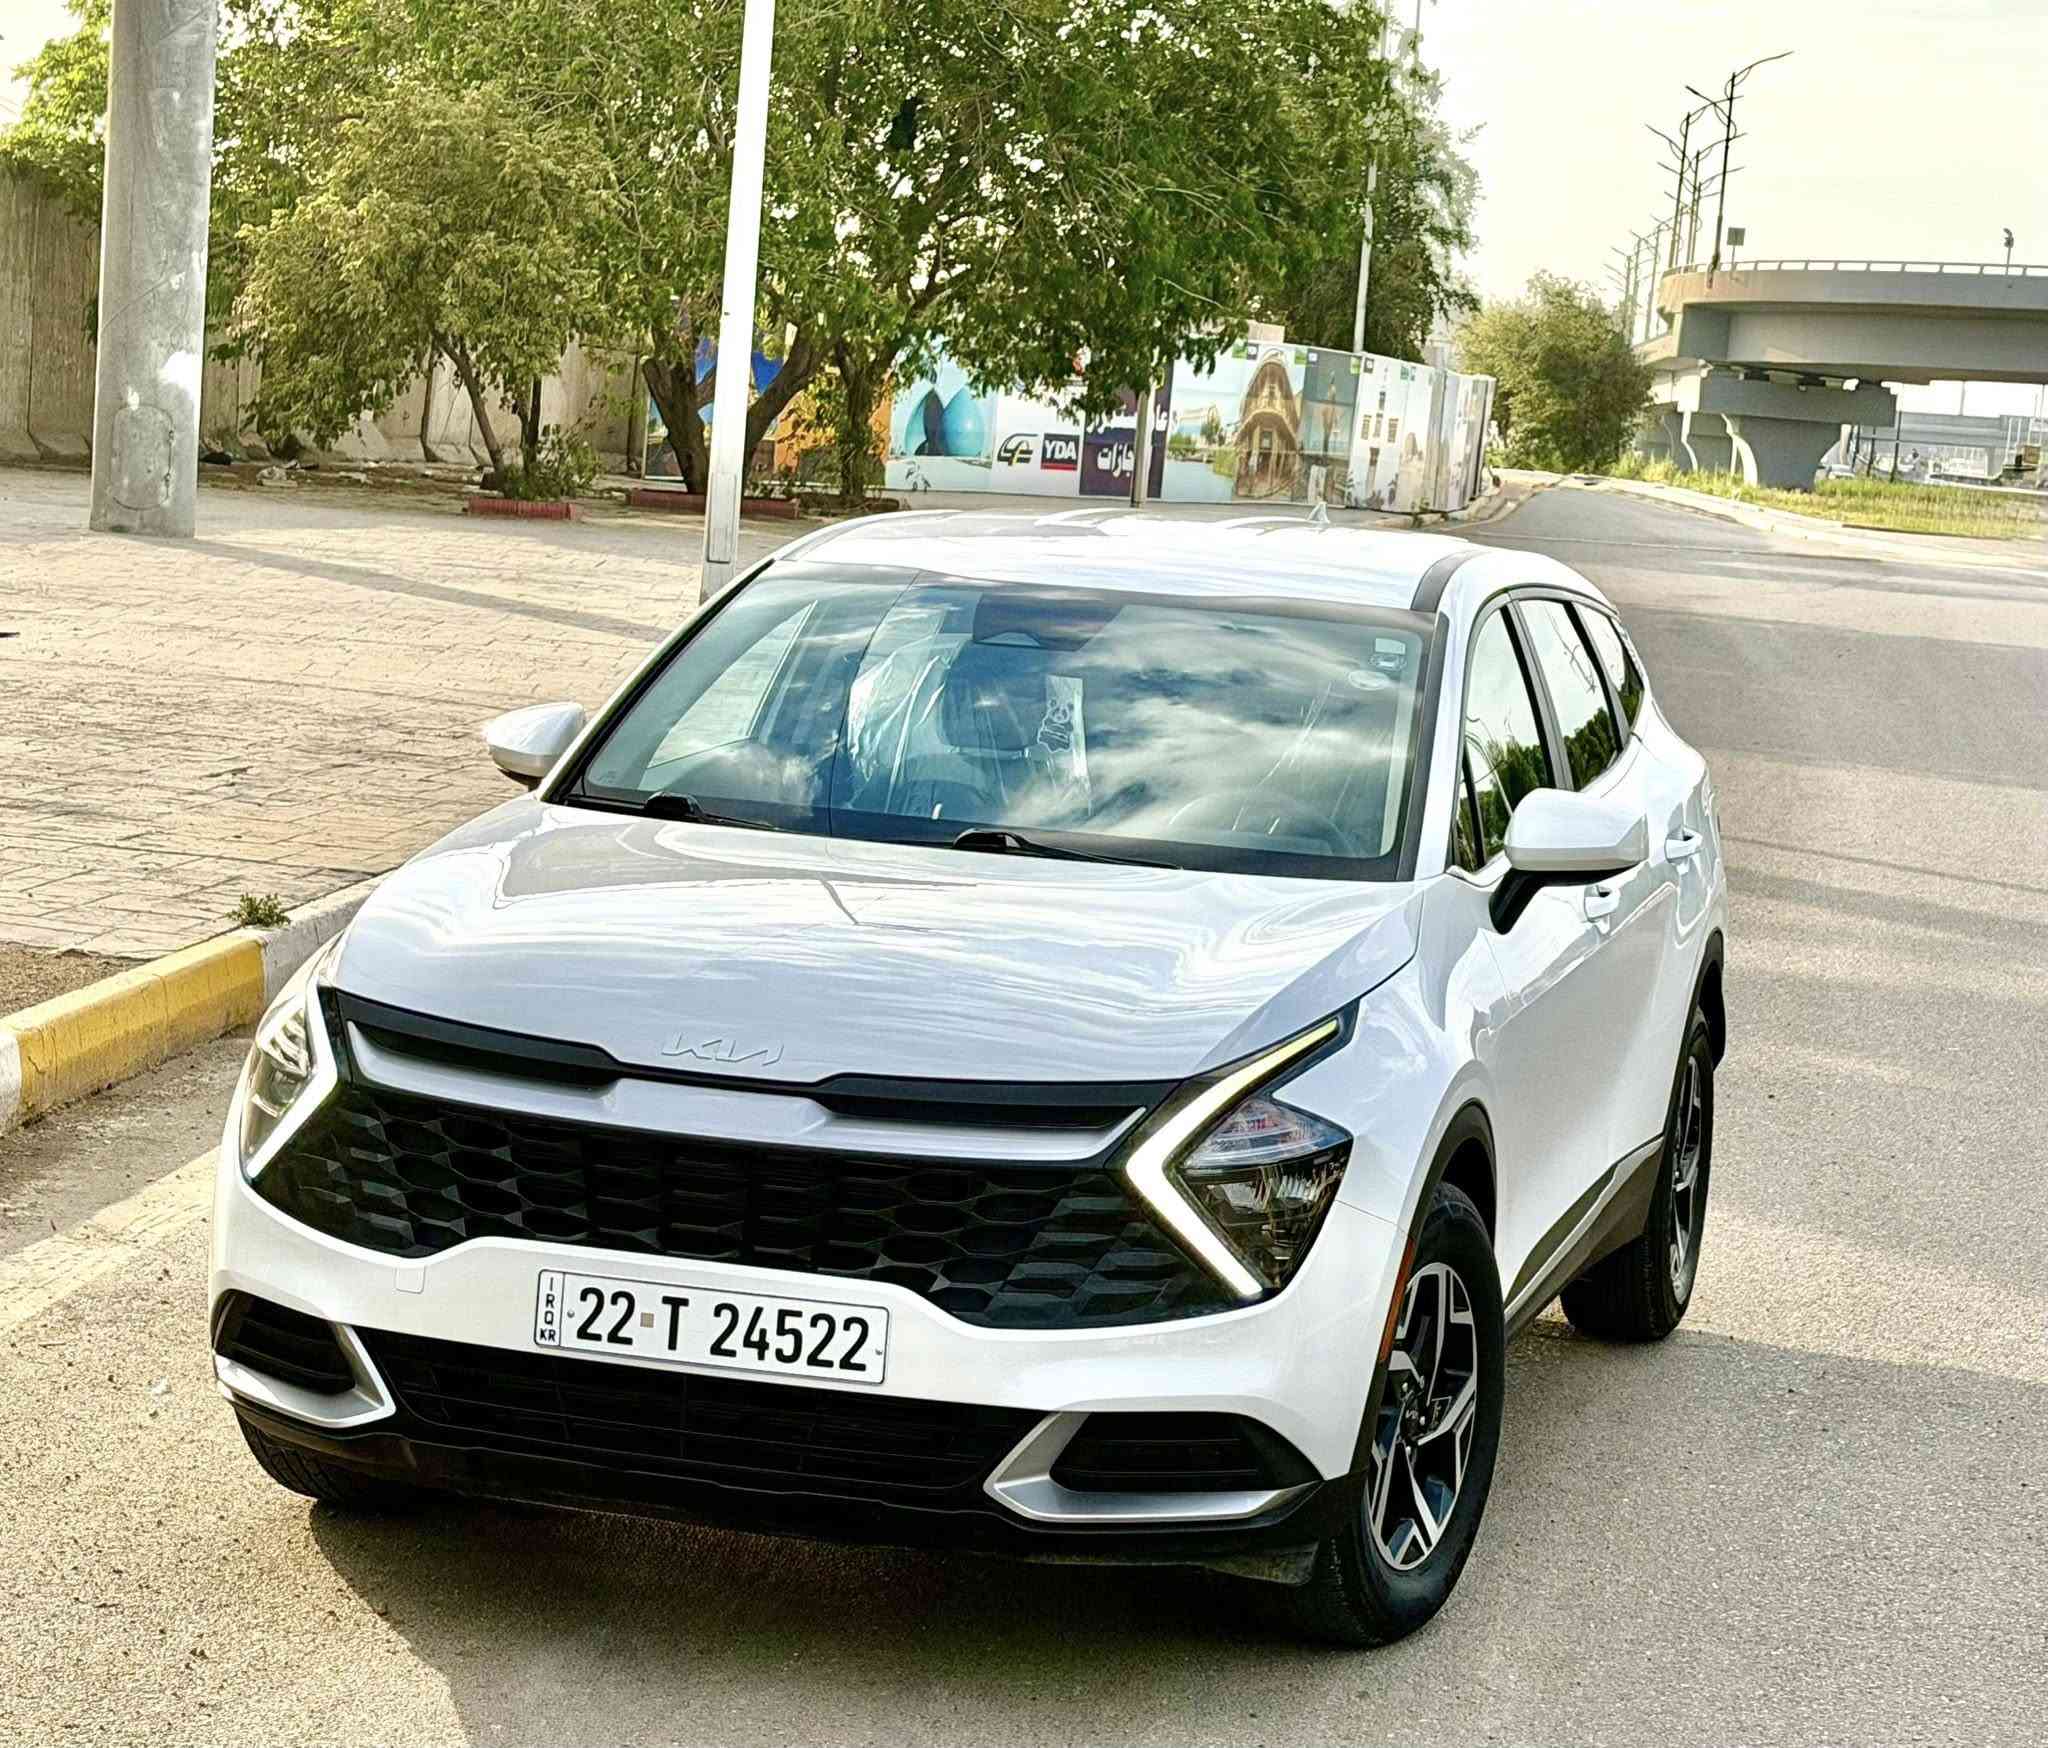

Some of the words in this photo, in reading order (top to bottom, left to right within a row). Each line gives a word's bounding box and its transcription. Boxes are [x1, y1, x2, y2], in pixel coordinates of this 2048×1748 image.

[1044, 440, 1077, 460] YDA
[660, 1031, 784, 1067] KIA
[543, 1277, 555, 1326] IRQ
[540, 1328, 556, 1342] KR
[577, 1287, 635, 1346] 22
[662, 1295, 690, 1351] T
[709, 1302, 869, 1372] 24522
